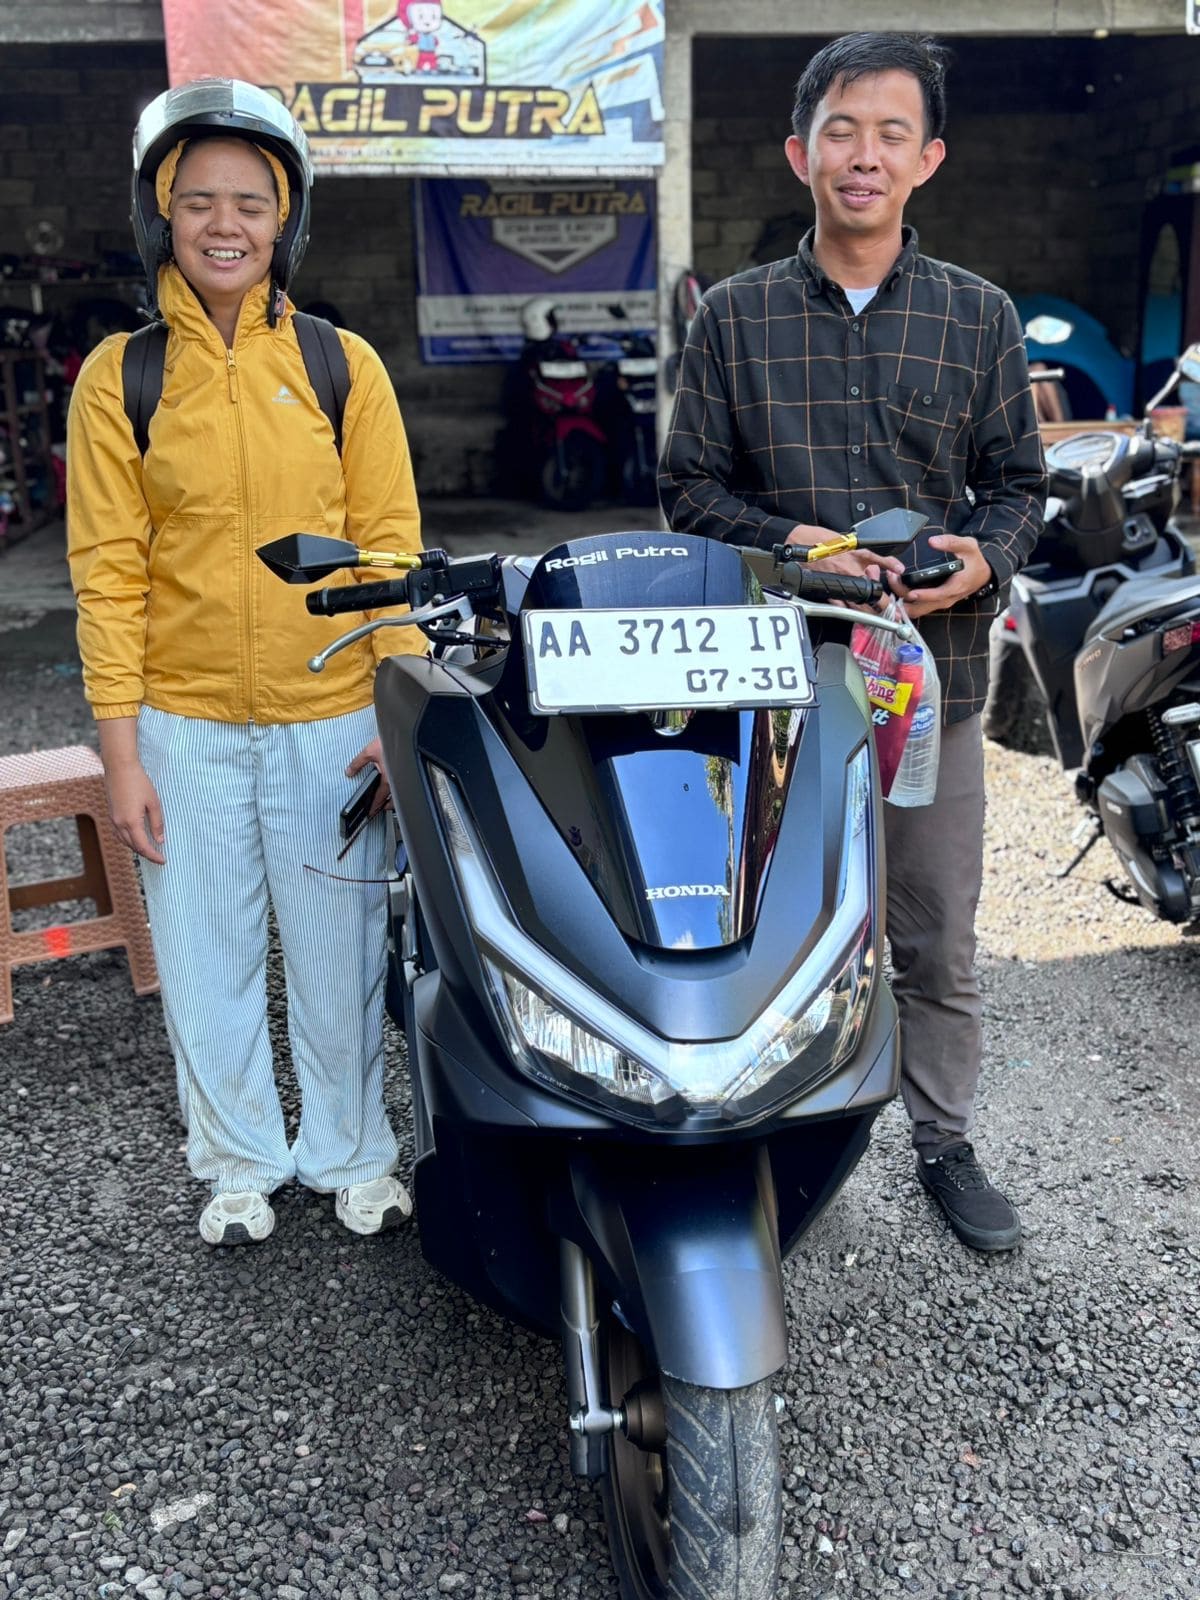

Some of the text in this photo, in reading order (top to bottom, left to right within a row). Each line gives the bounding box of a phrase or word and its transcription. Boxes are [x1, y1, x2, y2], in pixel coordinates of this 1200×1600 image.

[265, 81, 606, 136] AGIL PUTRA
[460, 190, 647, 217] RAGIL PUTRA
[545, 546, 689, 573] Ragil Putra
[539, 615, 790, 658] AA 3712 IP
[645, 885, 730, 900] HONDA
